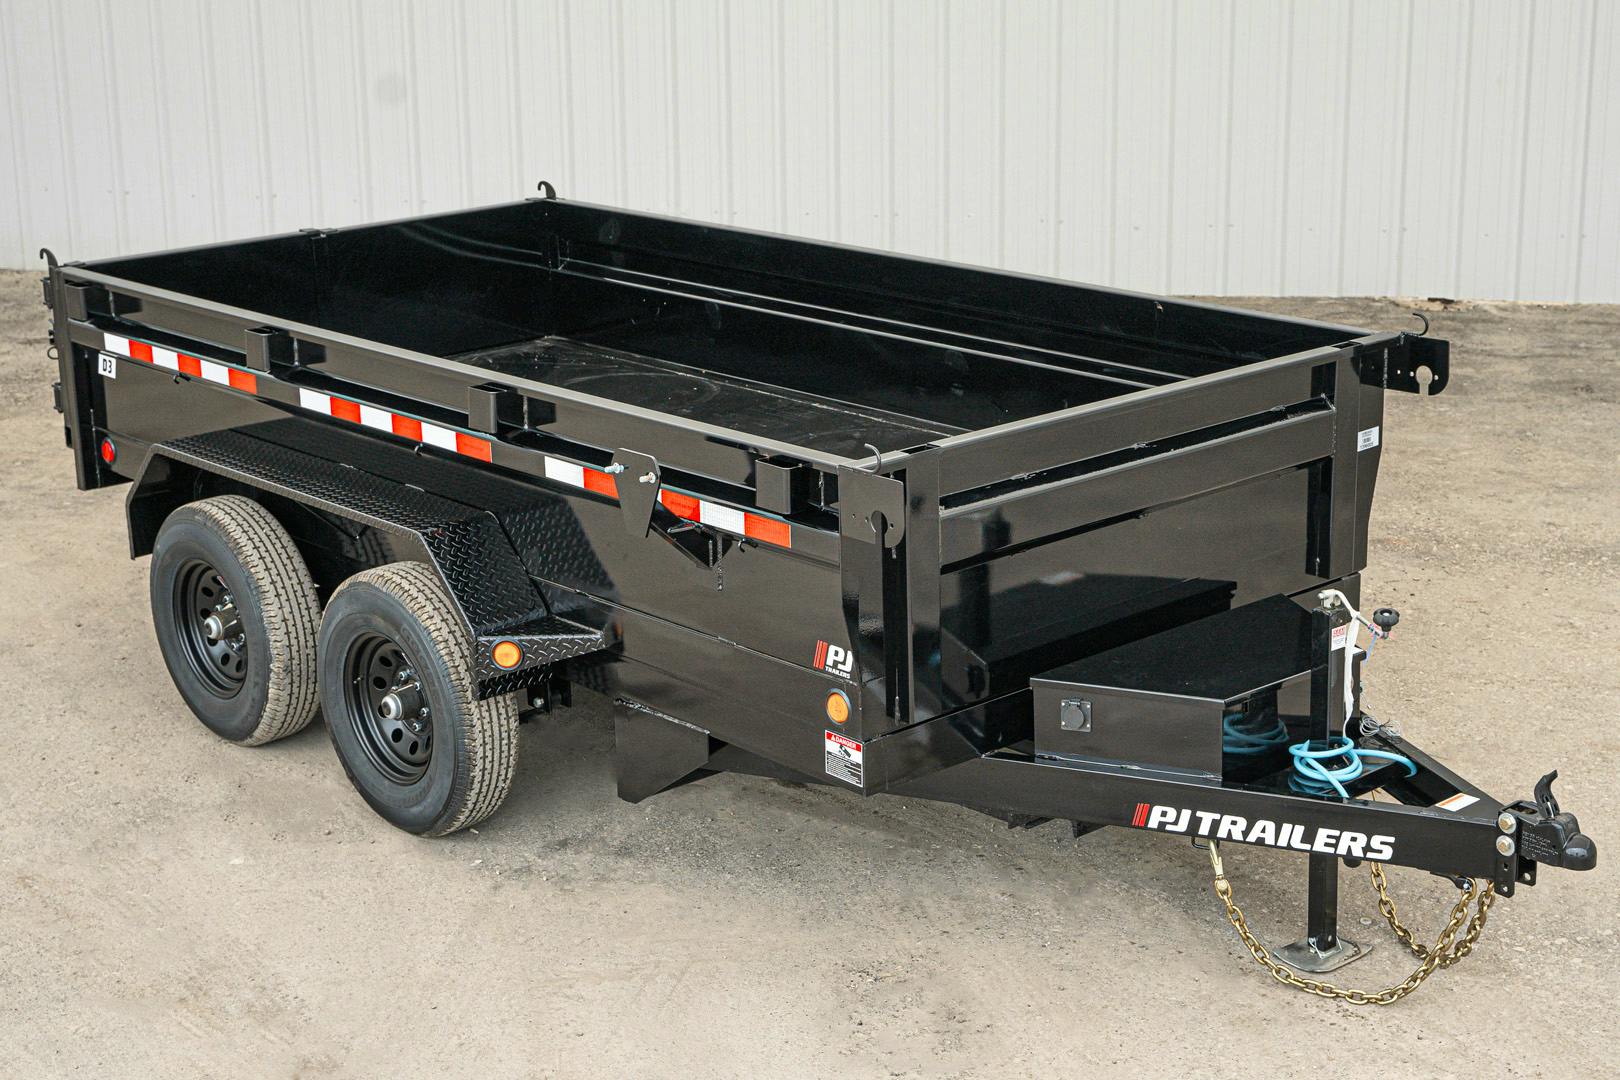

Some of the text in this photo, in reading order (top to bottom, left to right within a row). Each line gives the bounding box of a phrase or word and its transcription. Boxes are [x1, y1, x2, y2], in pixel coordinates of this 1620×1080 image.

[102, 358, 113, 374] D3
[826, 644, 853, 673] PJ
[825, 666, 851, 679] TRAILERS
[835, 735, 857, 750] DANGER
[1147, 805, 1396, 861] PJ TRAILERS
